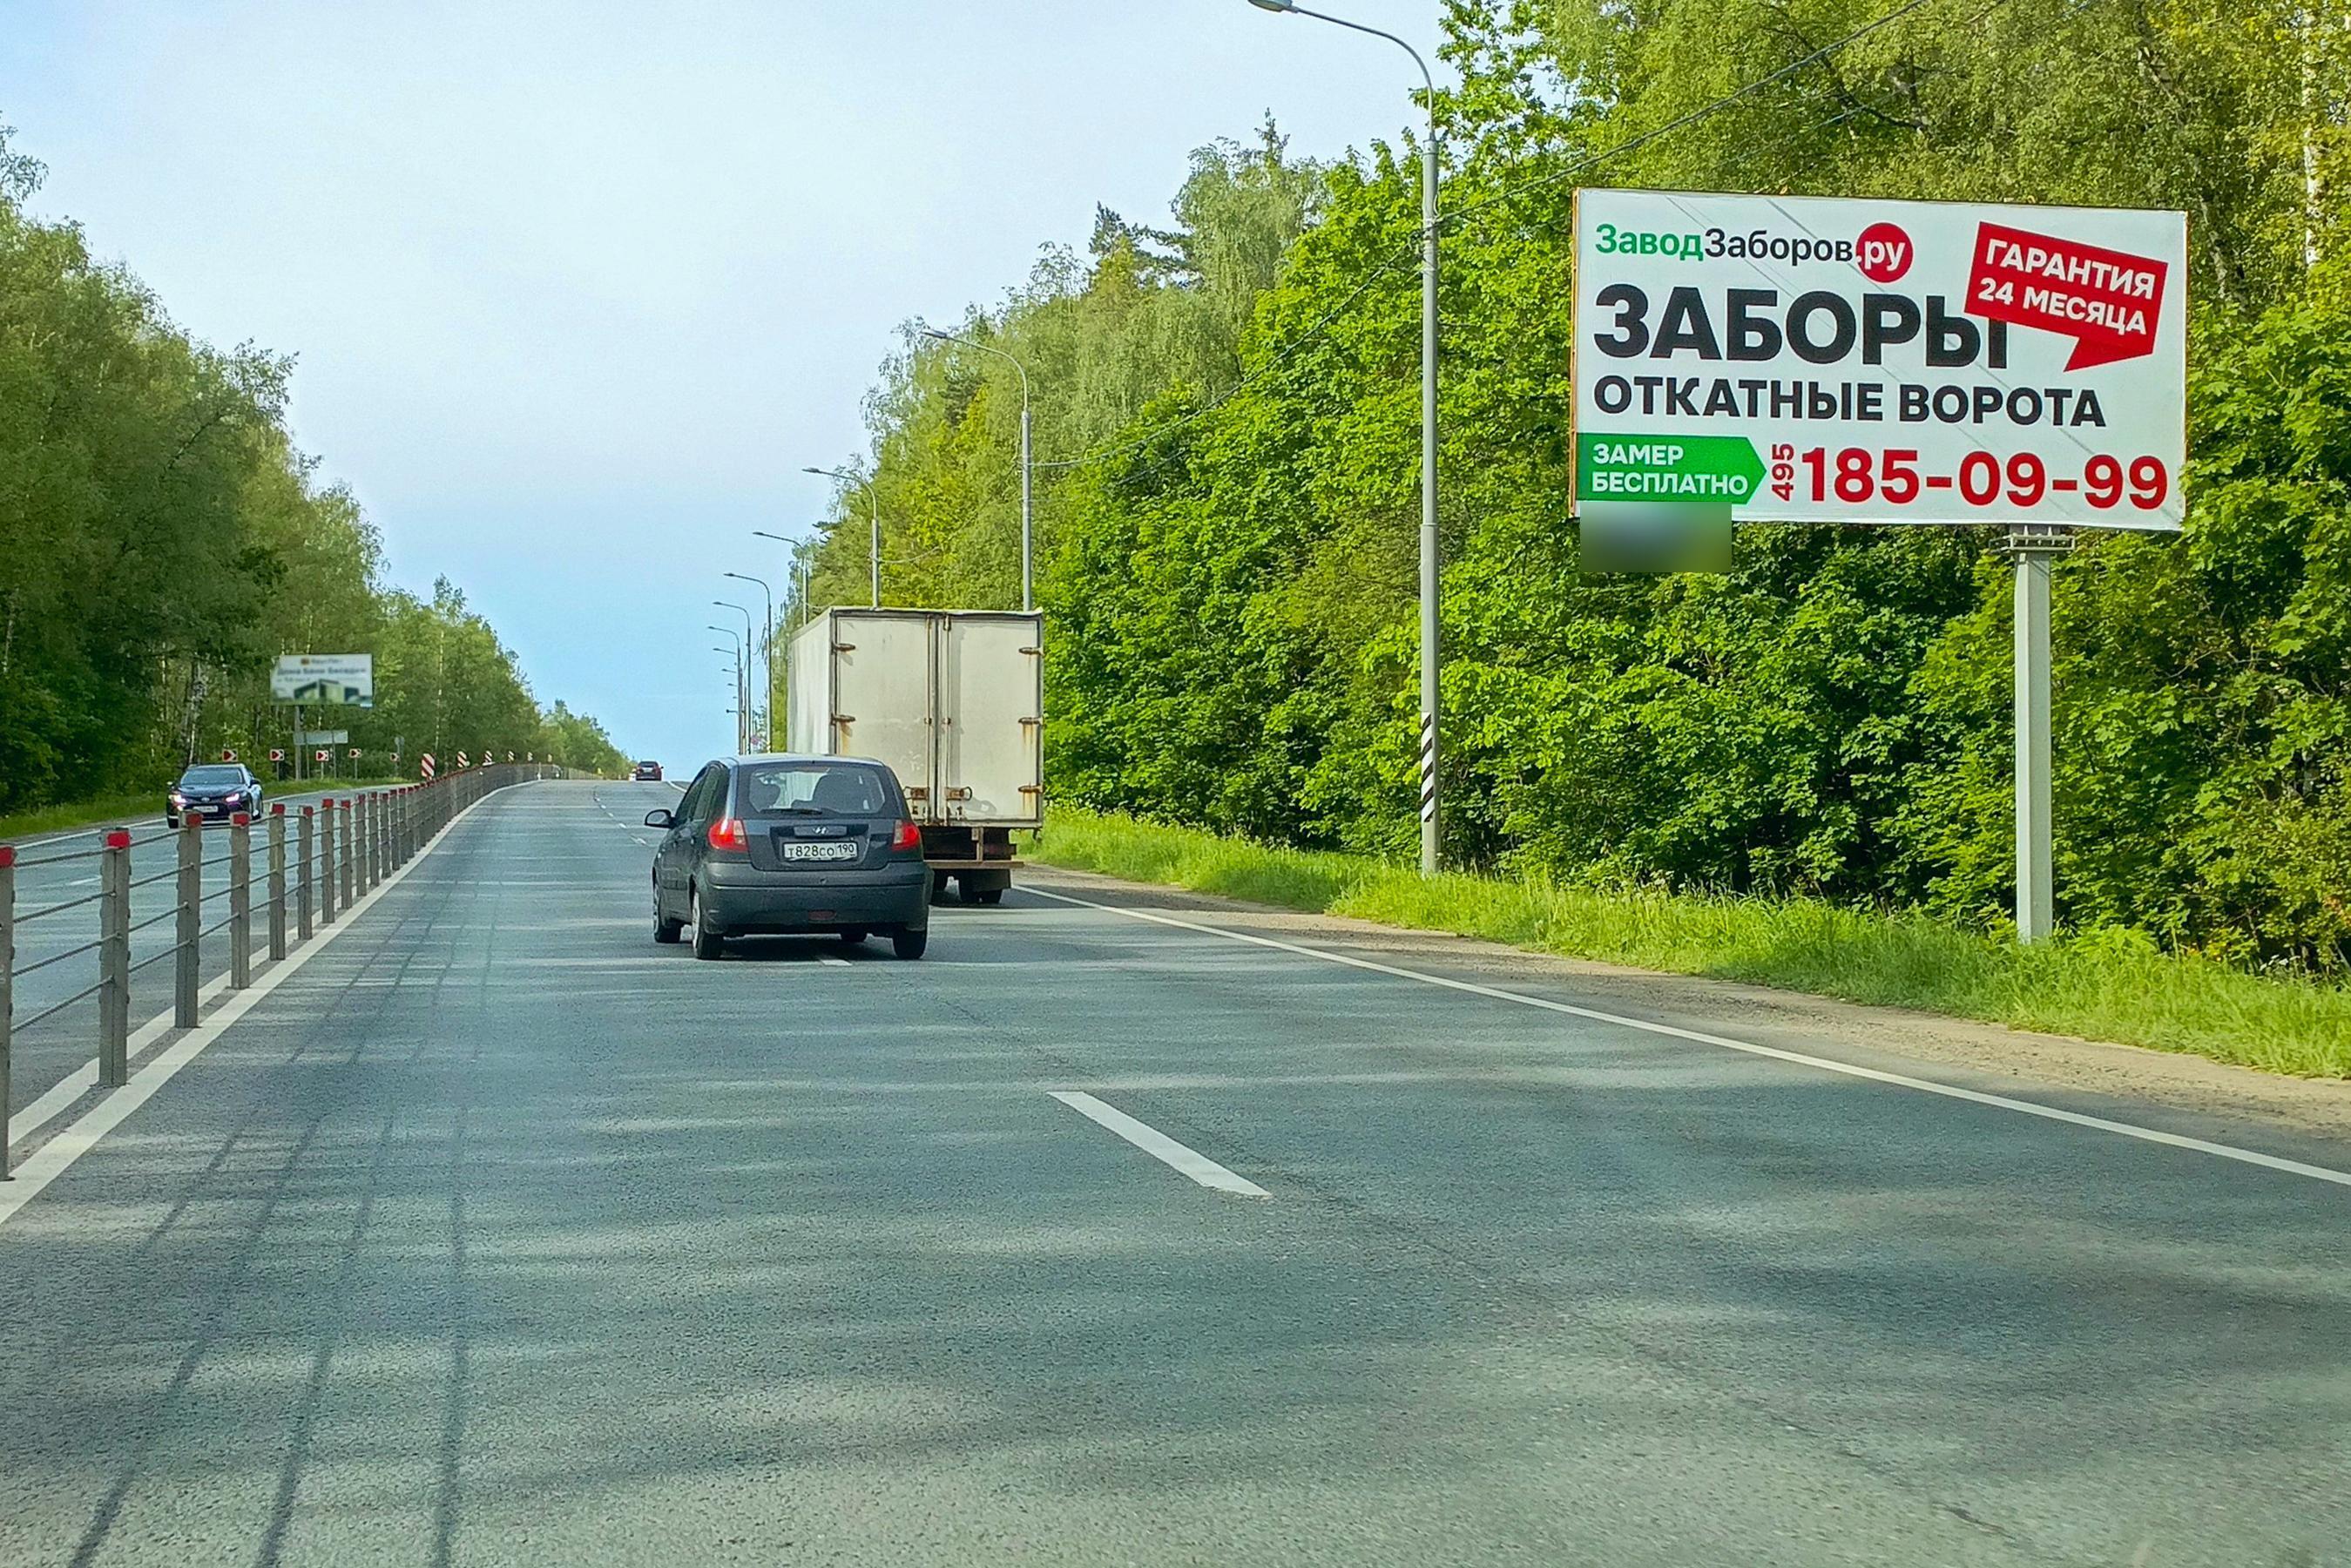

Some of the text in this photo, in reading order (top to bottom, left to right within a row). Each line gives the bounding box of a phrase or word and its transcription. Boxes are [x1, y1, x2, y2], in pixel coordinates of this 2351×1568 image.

[1595, 223, 1906, 272] ЗаводЗаборов.ру
[1985, 238, 2157, 301] ГАРАНТИЯ
[1593, 283, 2008, 369] ЗАБОРЫ
[1977, 277, 2147, 336] 24 МЕСЯЦА
[1593, 375, 2107, 428] ОТКАТНЫЕ ВОРОТА
[1592, 443, 1684, 466] ЗАМЕР
[1771, 443, 2168, 510] 495 185-09-99
[1591, 471, 1749, 497] БЕСПЛАТНО
